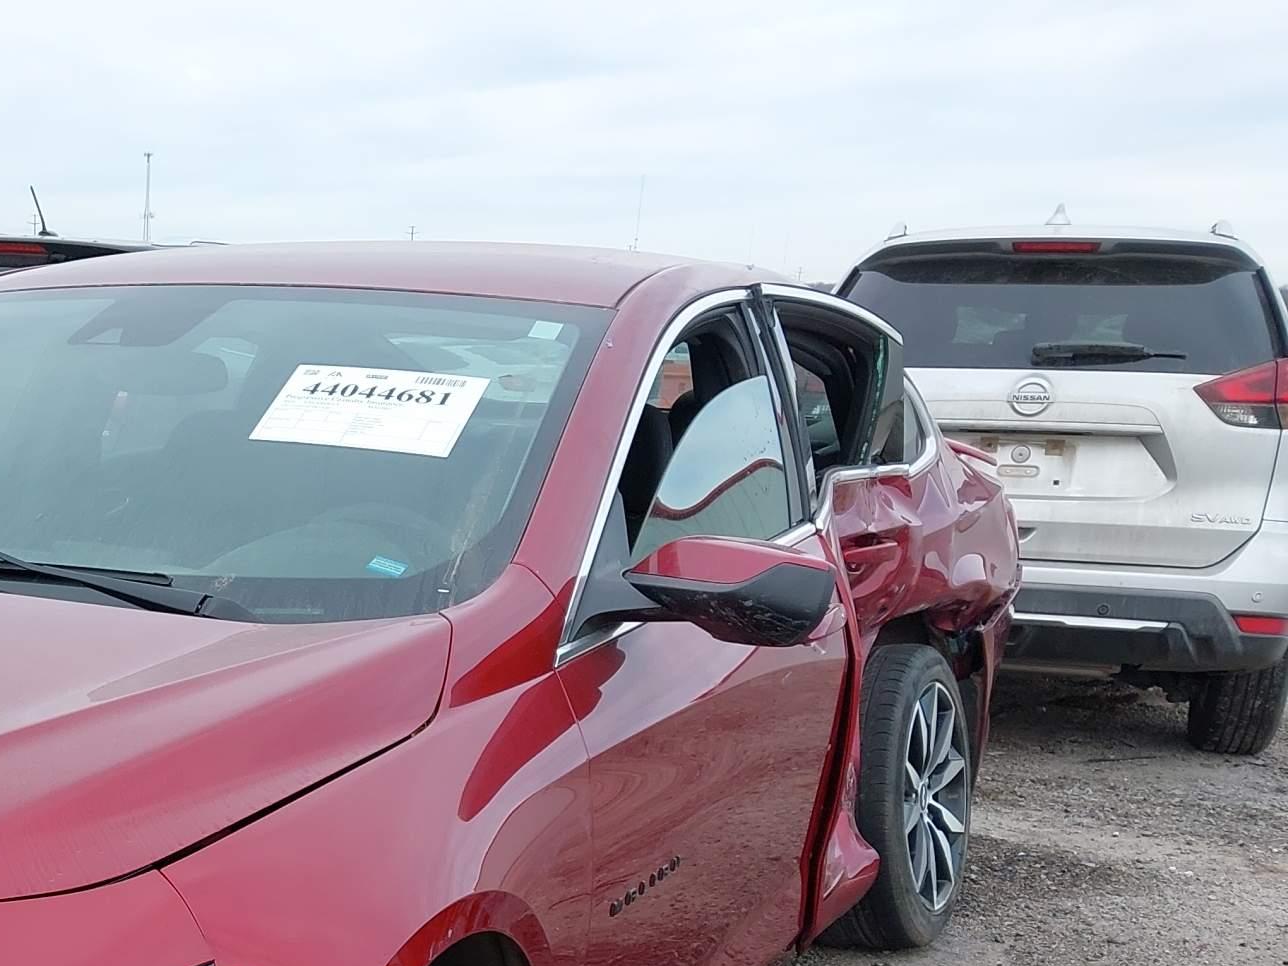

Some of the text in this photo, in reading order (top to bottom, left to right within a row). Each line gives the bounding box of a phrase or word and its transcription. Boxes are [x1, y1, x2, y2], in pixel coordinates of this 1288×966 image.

[302, 381, 451, 406] 44044681
[1190, 512, 1252, 526] SV AWD
